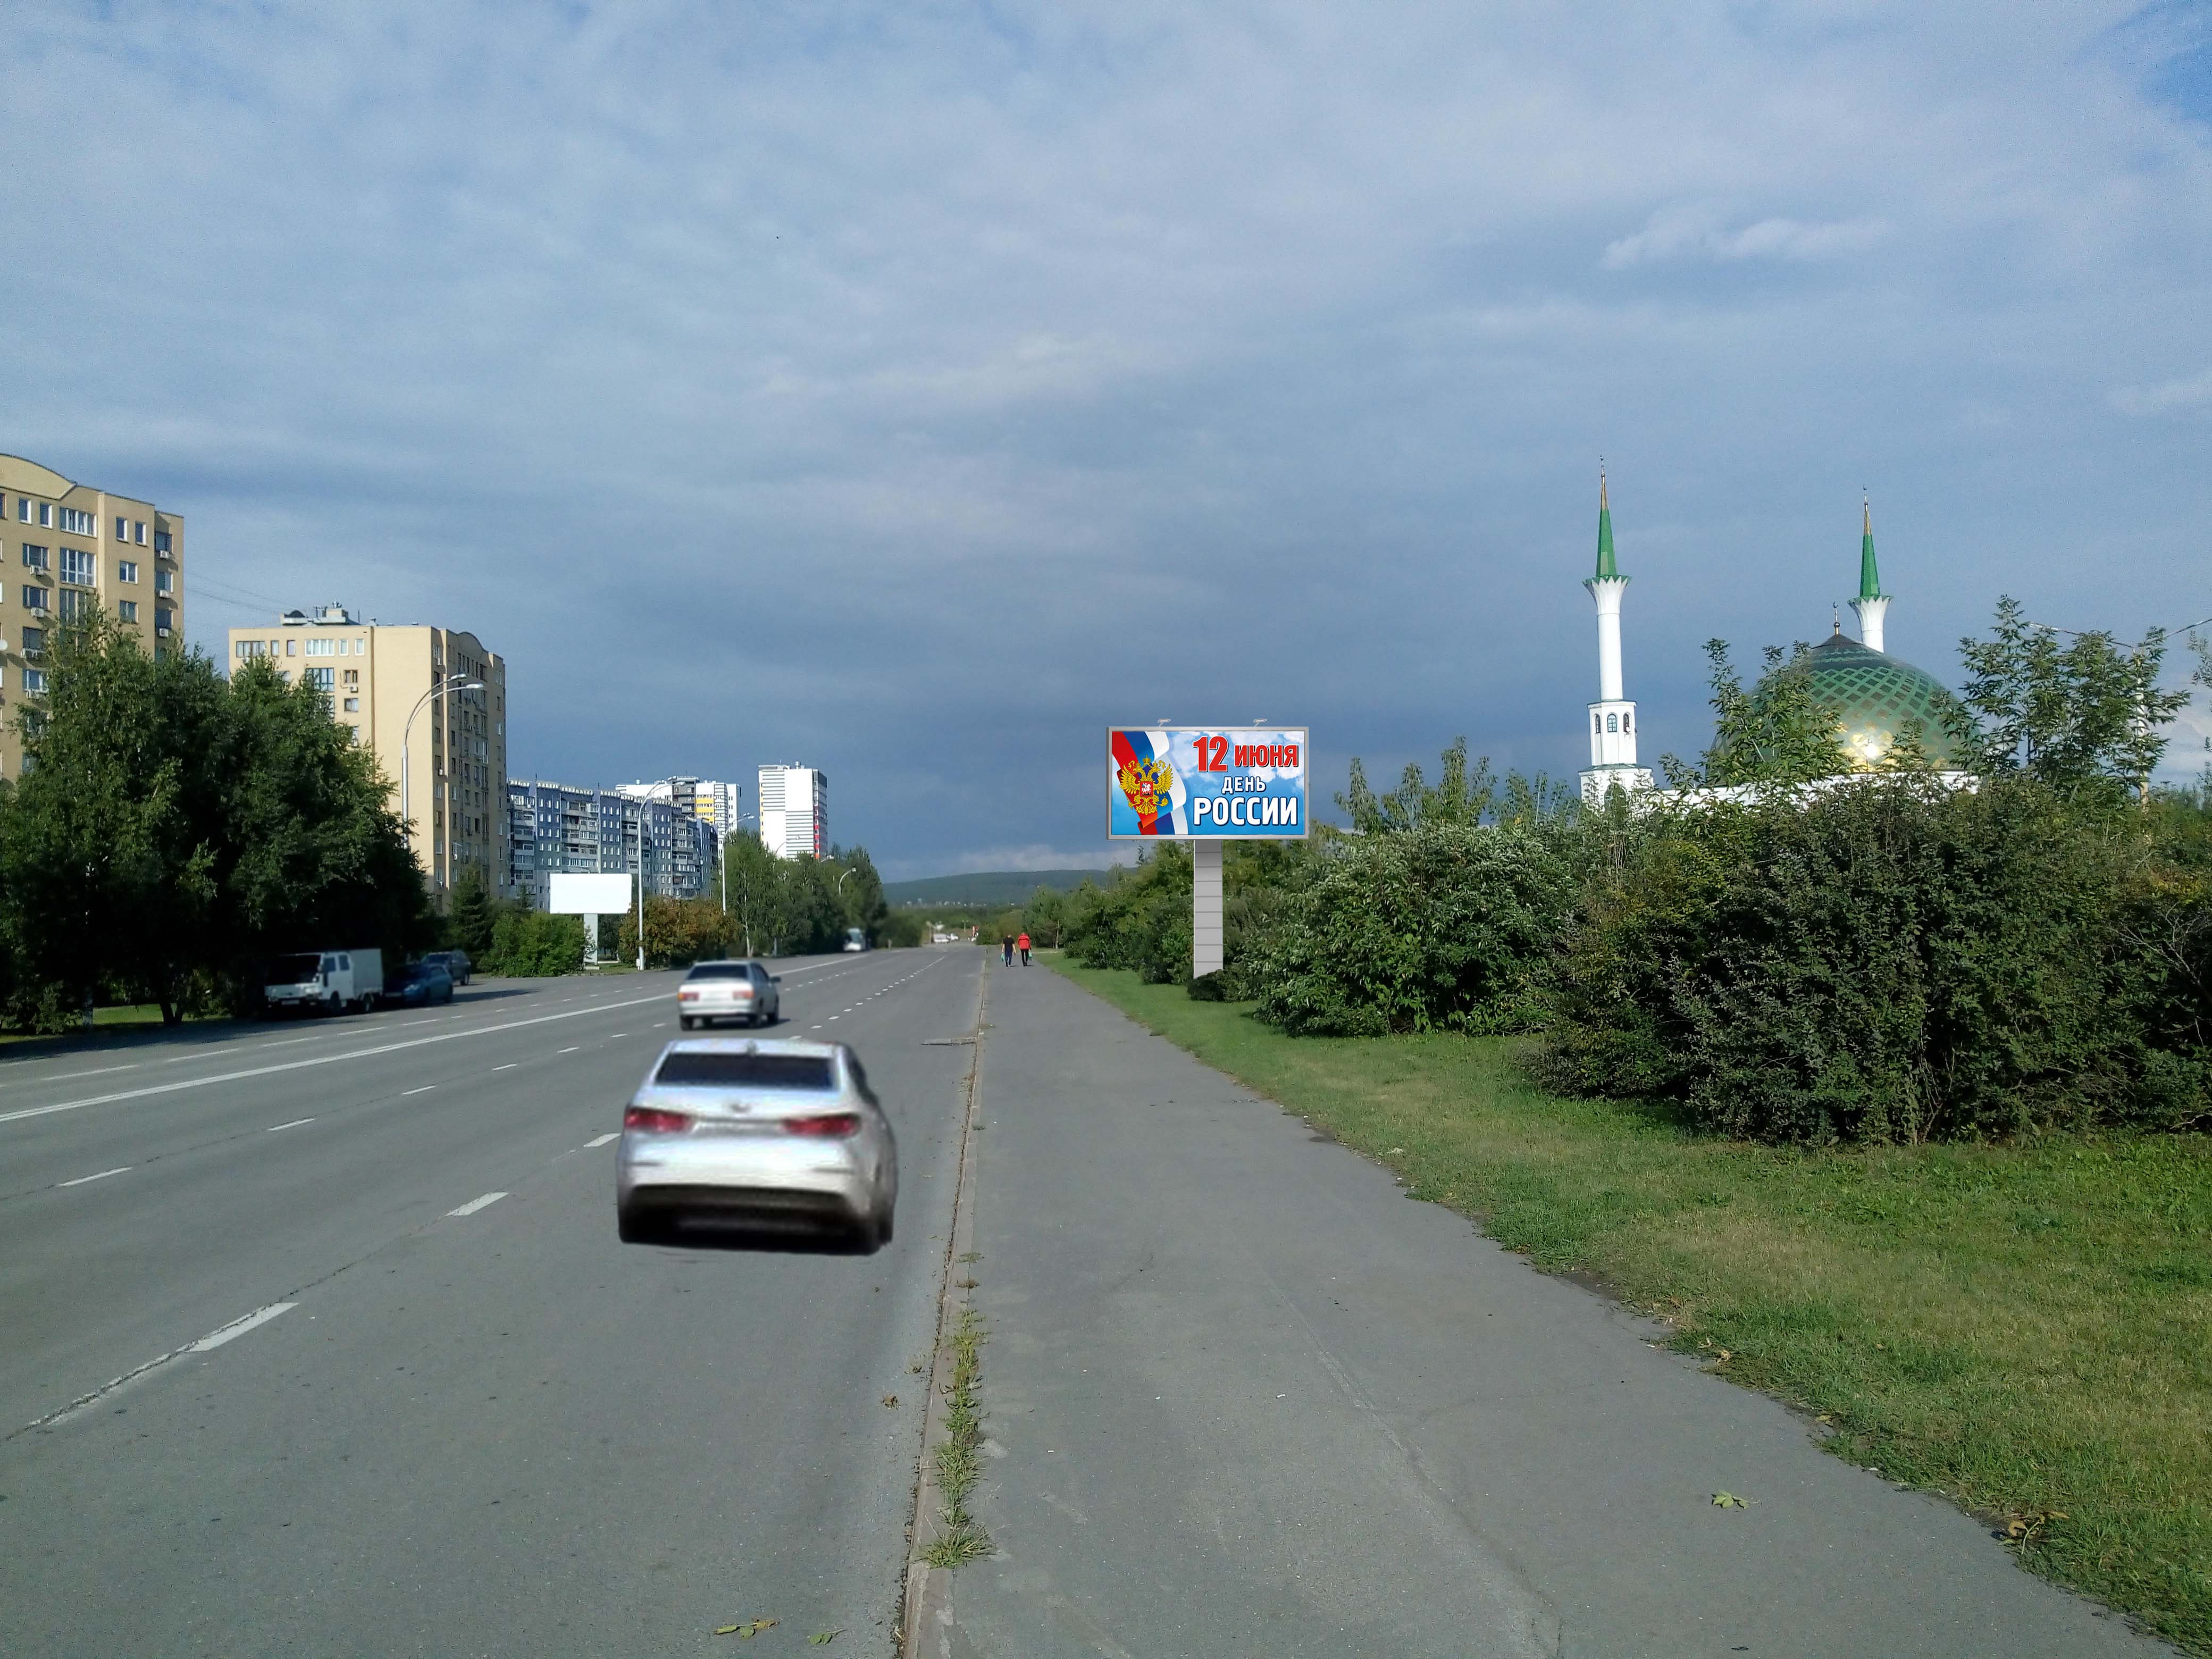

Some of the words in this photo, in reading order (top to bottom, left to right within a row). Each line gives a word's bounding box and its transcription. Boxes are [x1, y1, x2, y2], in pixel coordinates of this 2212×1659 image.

[1193, 735, 1228, 772] 12
[1234, 744, 1298, 767] ИЮНЯ
[1222, 776, 1266, 794] ДЕНЬ
[1193, 797, 1297, 825] РОССИИ
